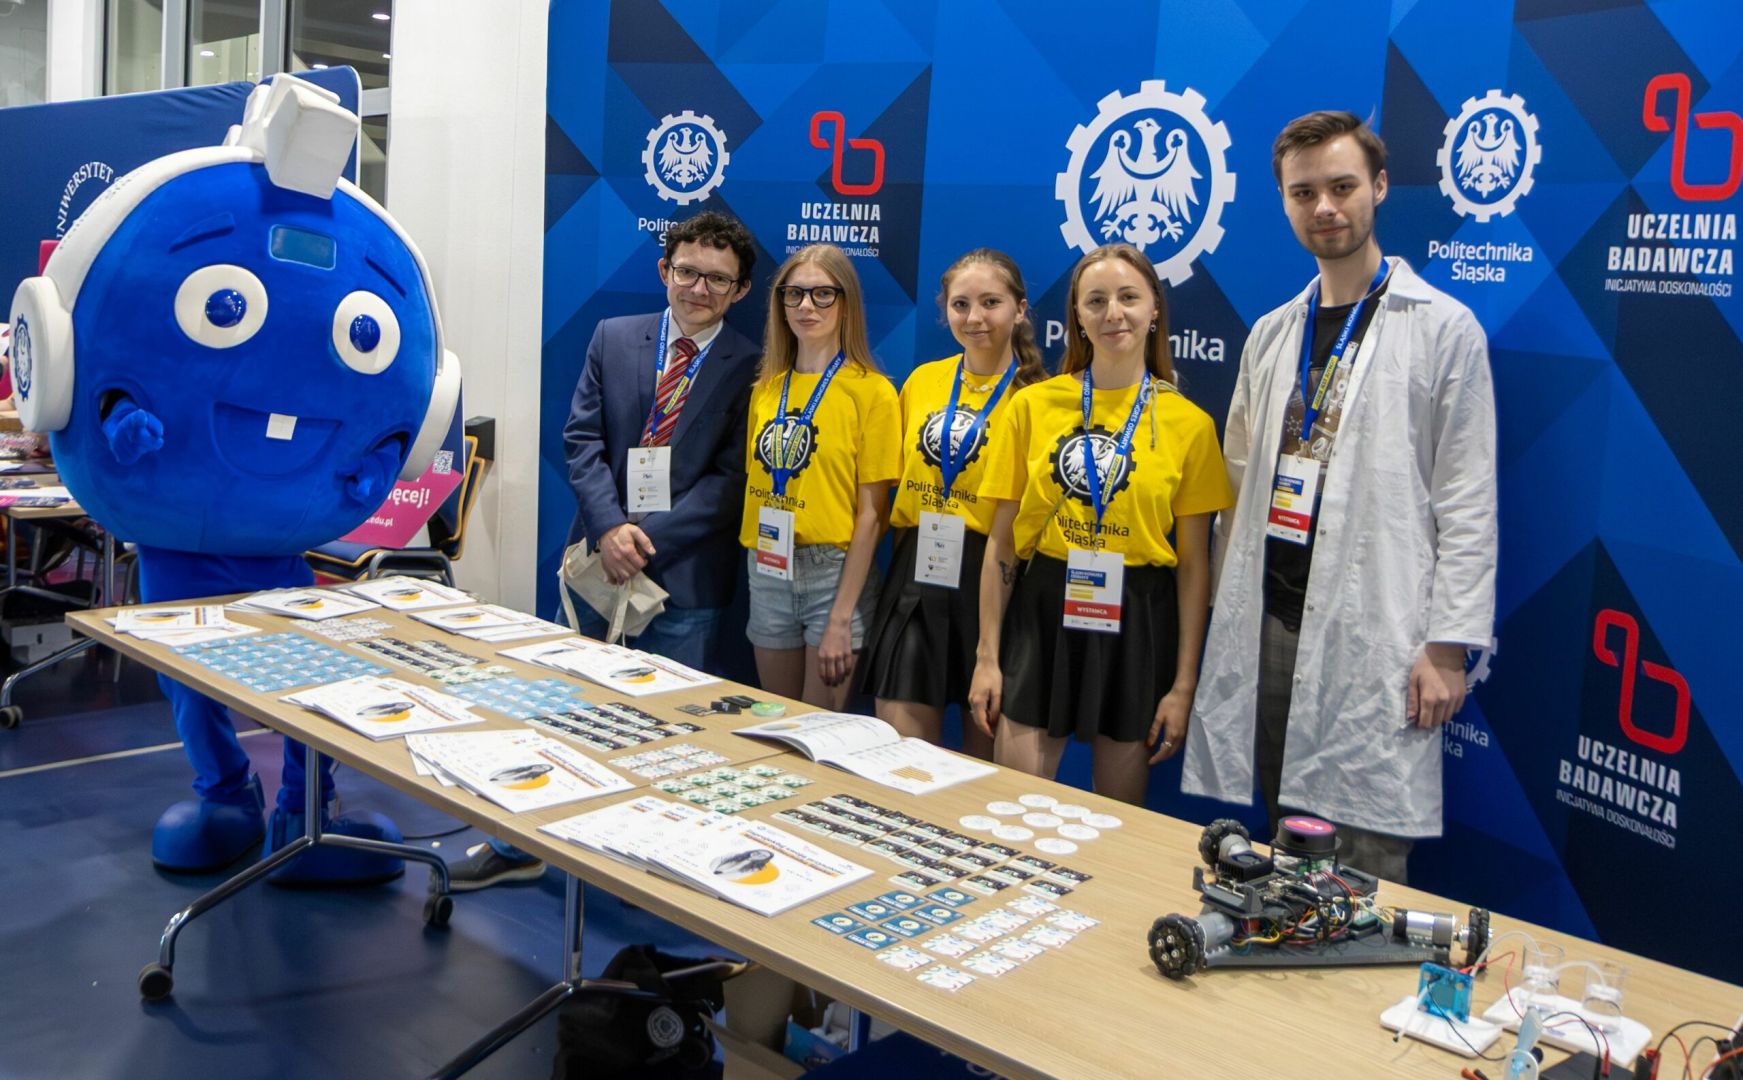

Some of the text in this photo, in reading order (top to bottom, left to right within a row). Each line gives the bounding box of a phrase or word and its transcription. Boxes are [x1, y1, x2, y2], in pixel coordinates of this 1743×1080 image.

[801, 202, 881, 221] UCZELNIA
[787, 223, 880, 243] BADAWCZA
[1627, 213, 1737, 240] UCZELNIA
[1428, 240, 1533, 262] Politechnika
[1607, 246, 1734, 275] BADAWCZA
[1451, 259, 1506, 284] Śląska
[1604, 278, 1732, 297] INICJATYWA DOSKONAŁOŚCI
[1578, 734, 1681, 797] UCZELNIA
[1559, 759, 1677, 829] BADAWCZA
